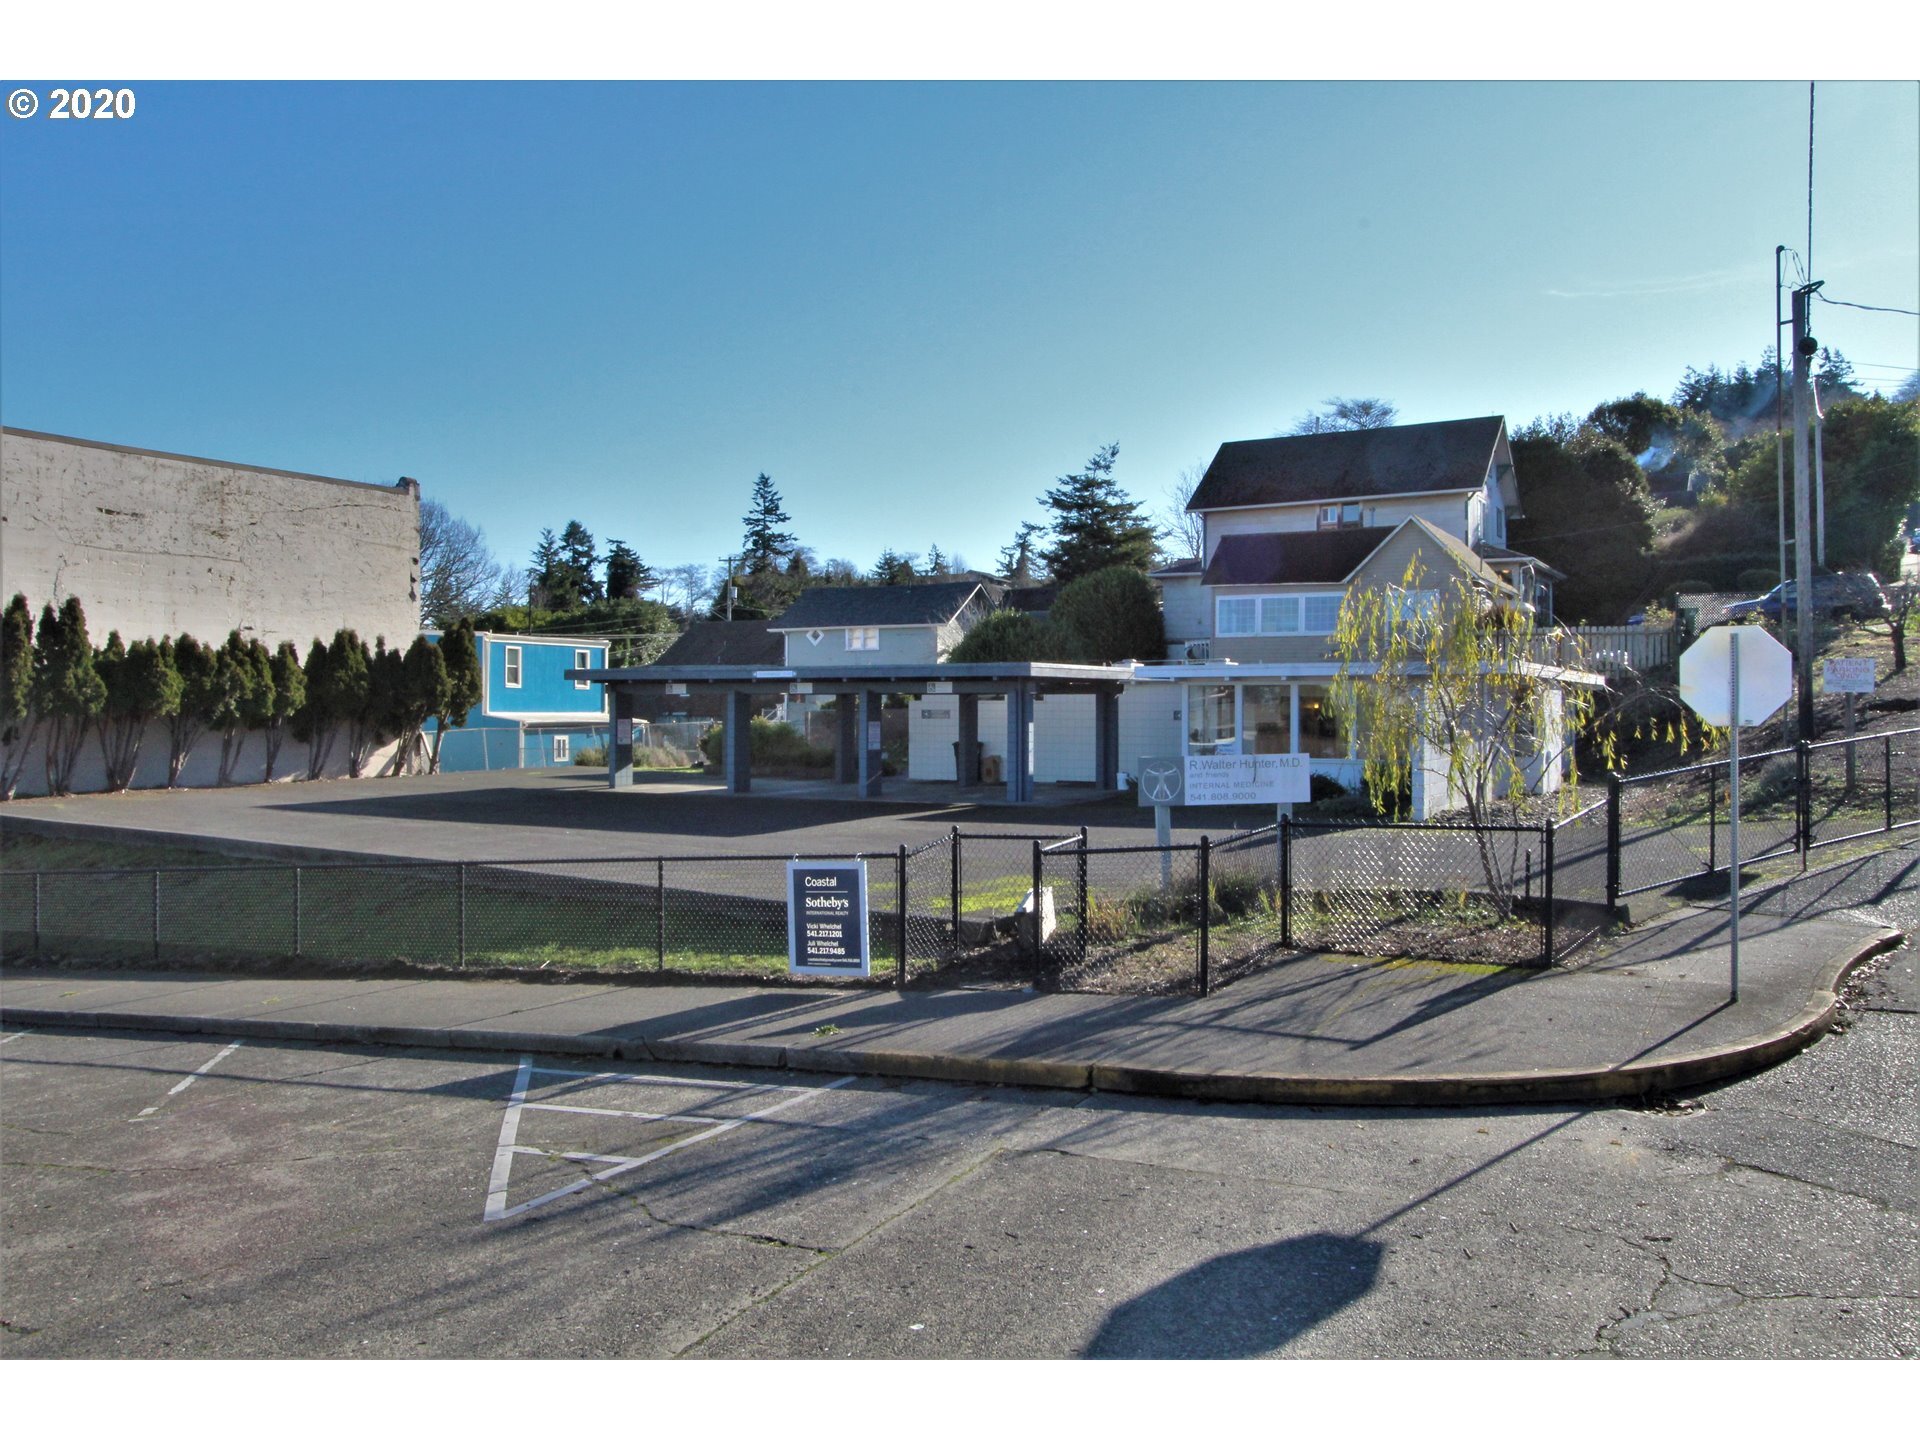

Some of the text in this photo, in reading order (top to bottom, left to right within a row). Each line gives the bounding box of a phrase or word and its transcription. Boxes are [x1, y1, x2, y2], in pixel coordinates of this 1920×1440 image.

[1279, 757, 1303, 768] M.D.
[1190, 780, 1274, 790] INTERNAL MEDICINE
[805, 876, 837, 887] Coastal
[805, 896, 849, 910] Sotheby's
[806, 930, 843, 938] 541.217.1201
[807, 946, 846, 955] 541.217.9485
